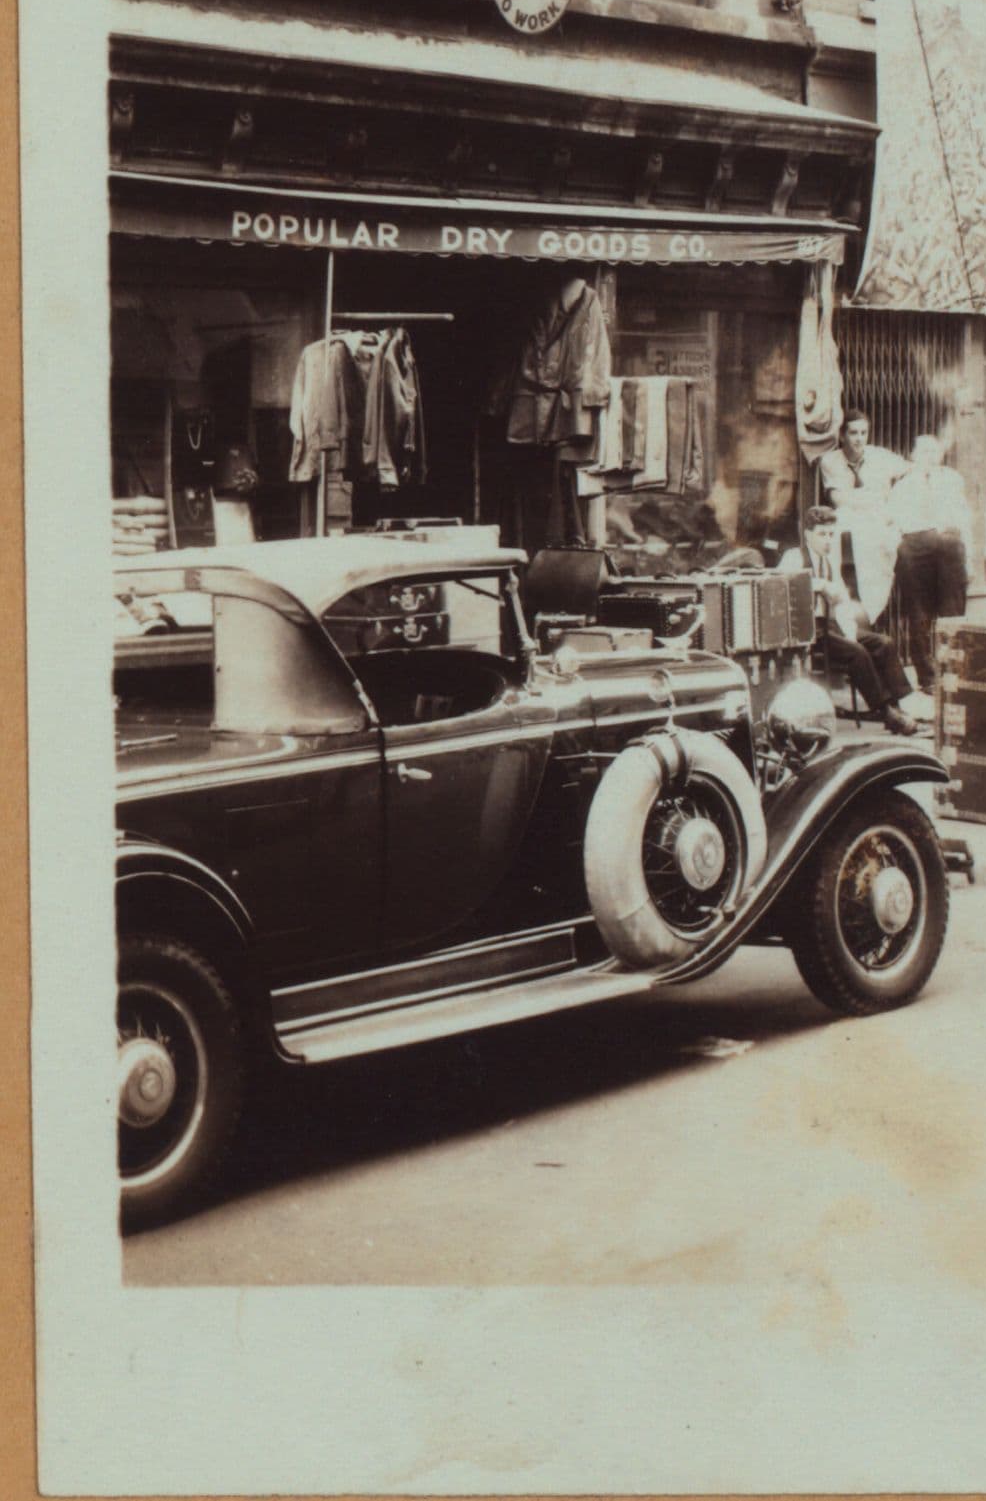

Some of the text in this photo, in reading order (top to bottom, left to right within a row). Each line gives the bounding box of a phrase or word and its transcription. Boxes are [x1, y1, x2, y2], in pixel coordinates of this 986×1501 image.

[514, 2, 560, 30] WORK
[231, 211, 714, 259] POPULAR DRY GOODS CO.
